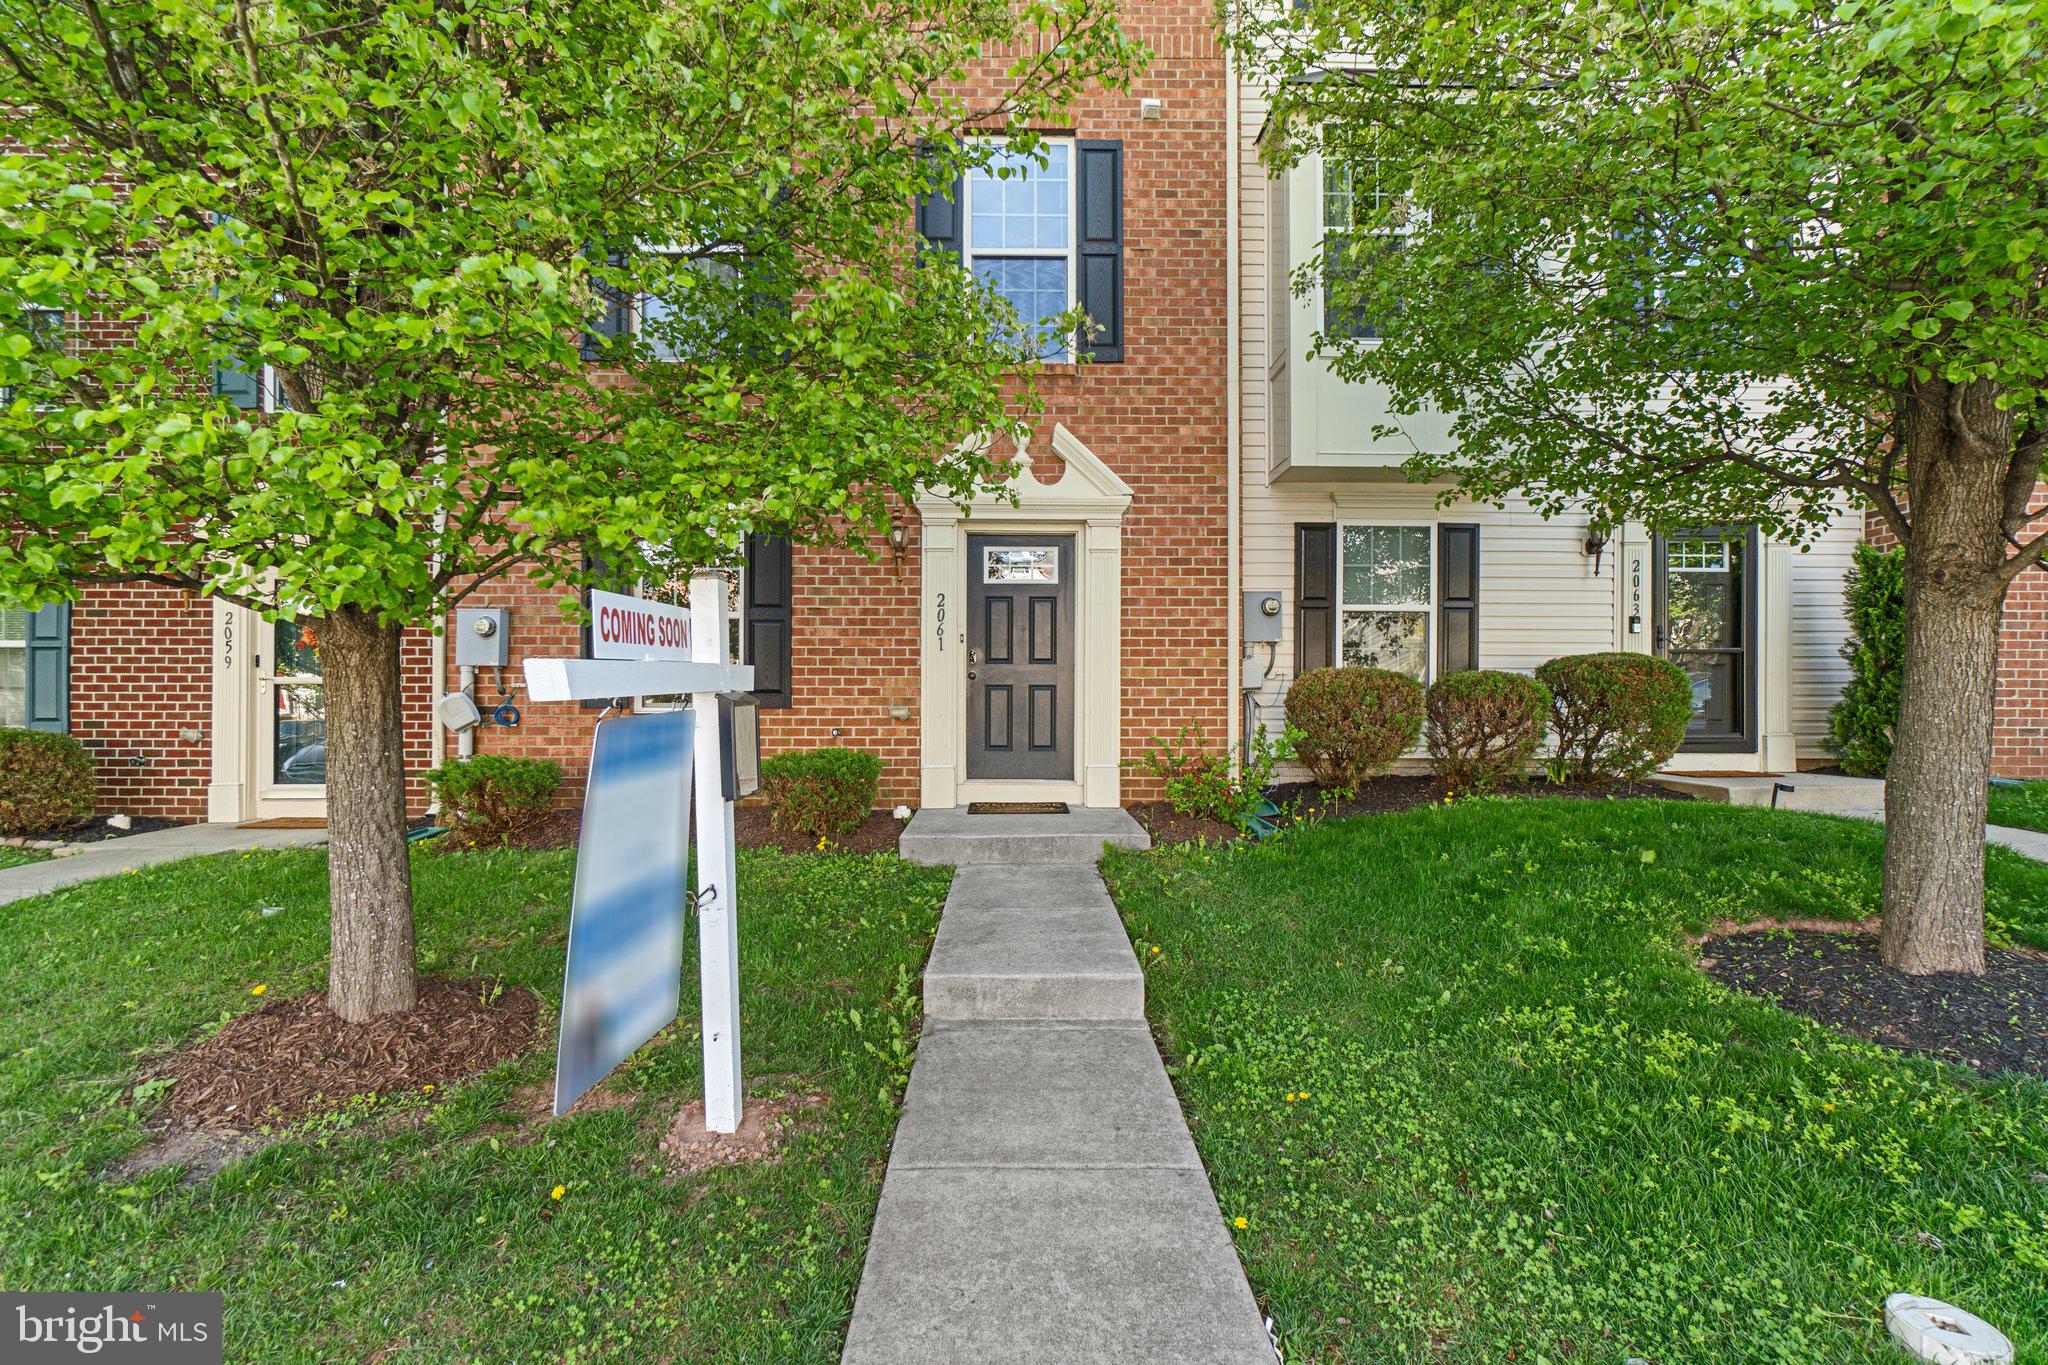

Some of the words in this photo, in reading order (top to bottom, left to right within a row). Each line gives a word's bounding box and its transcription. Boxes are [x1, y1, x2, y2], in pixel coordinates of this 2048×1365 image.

[1632, 559, 1640, 616] 2063
[224, 611, 233, 669] 2059
[601, 606, 656, 646] COMING
[658, 615, 688, 648] SOON
[936, 593, 946, 652] 2061
